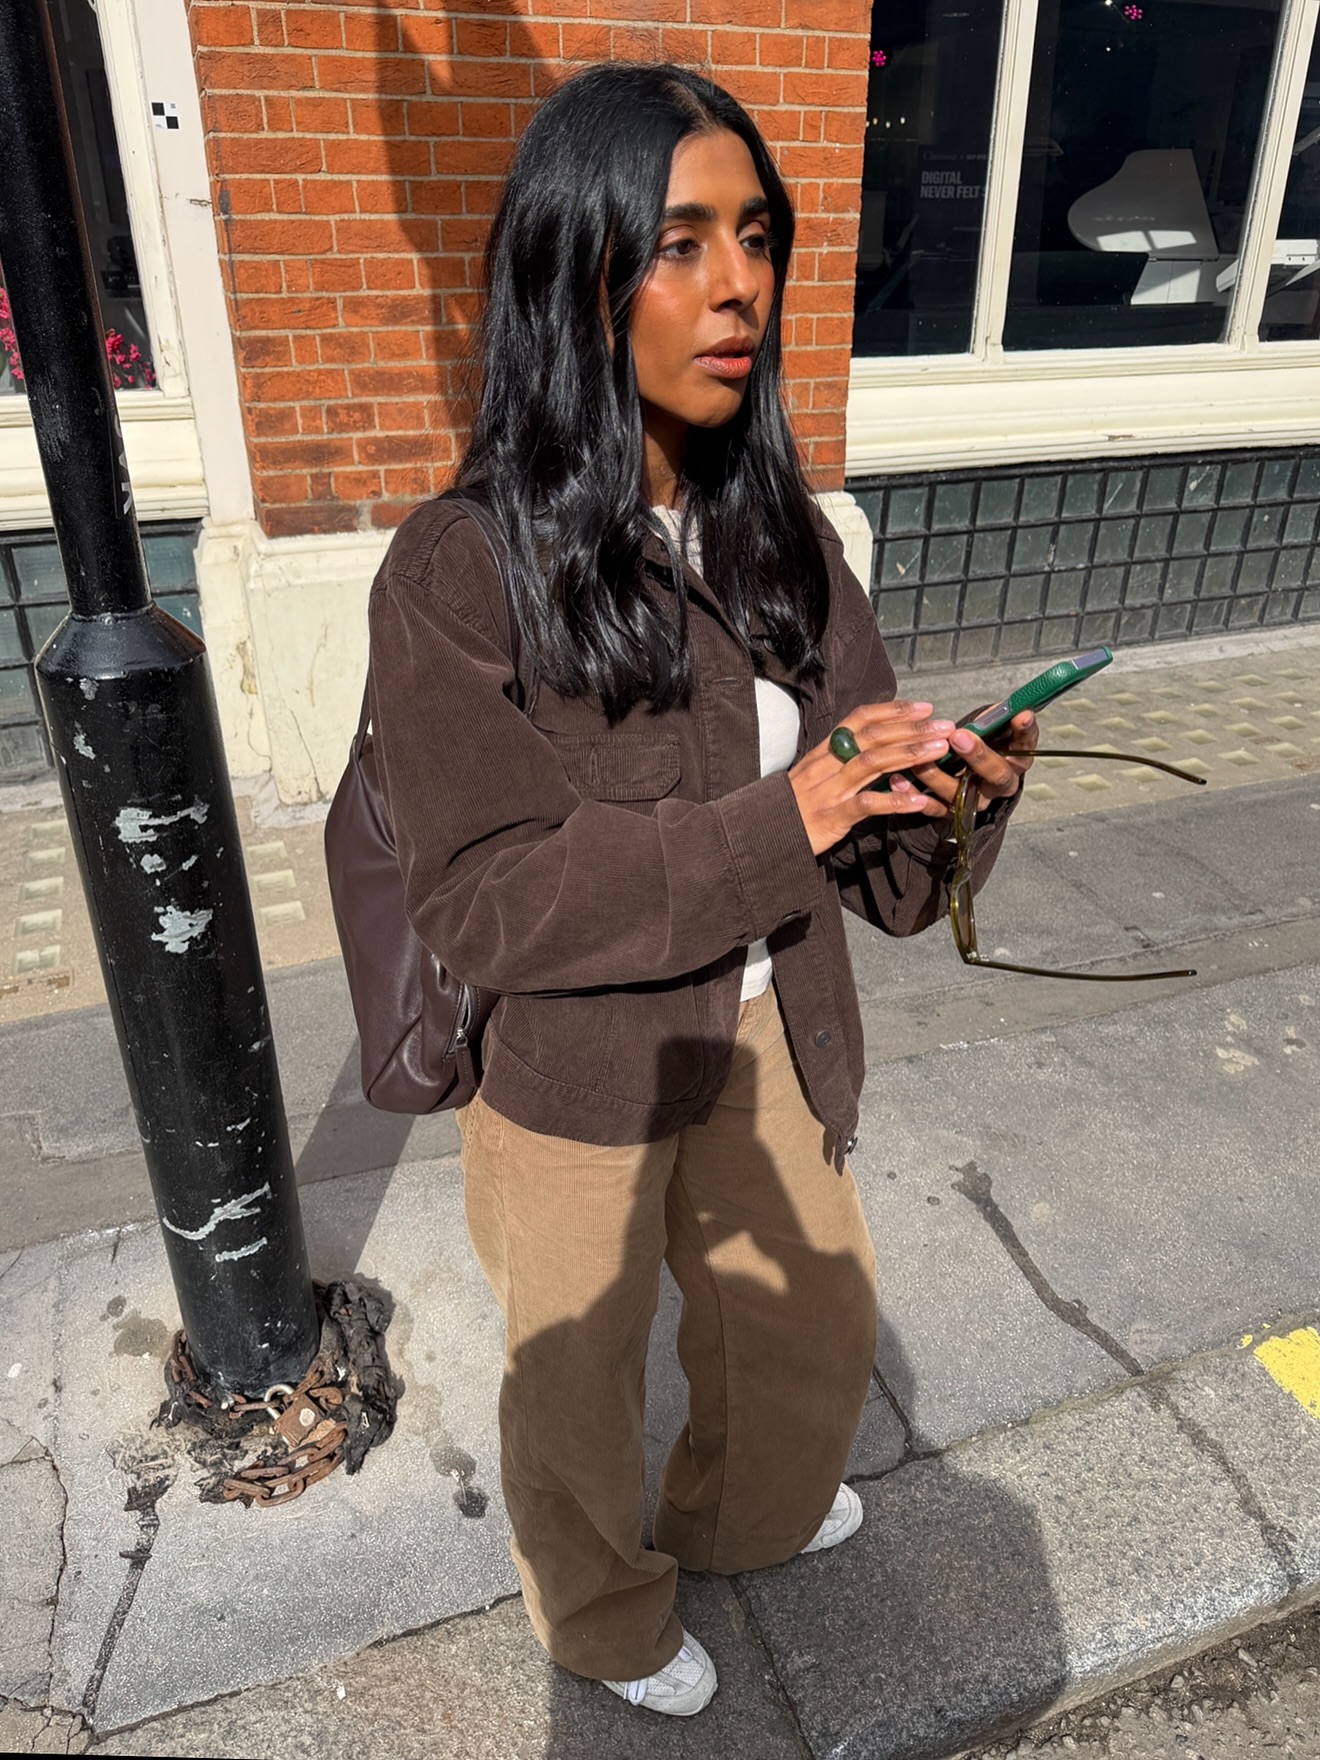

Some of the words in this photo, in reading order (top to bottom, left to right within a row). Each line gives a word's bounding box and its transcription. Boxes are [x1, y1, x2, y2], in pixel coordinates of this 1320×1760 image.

[921, 171, 963, 184] DIGITAL
[920, 185, 955, 198] NEVER
[956, 185, 981, 198] FELT
